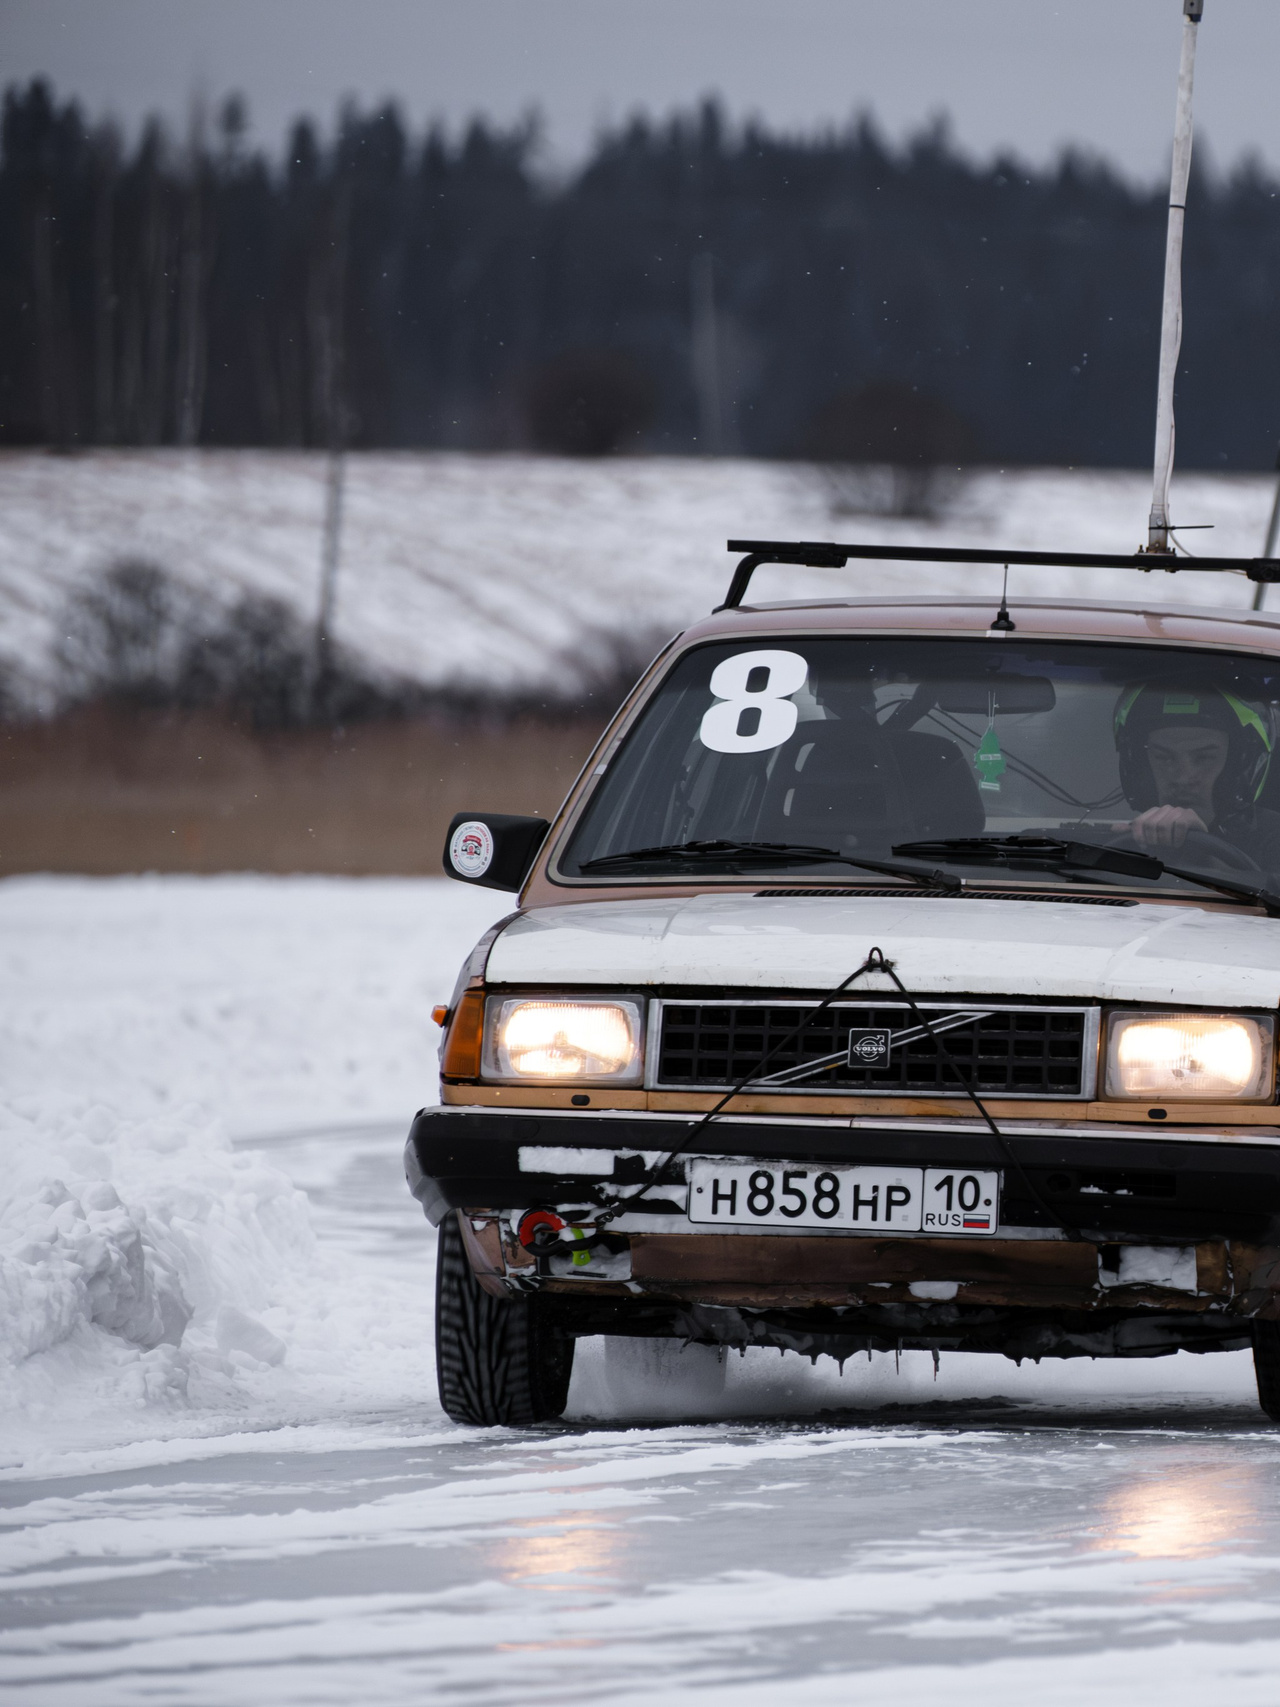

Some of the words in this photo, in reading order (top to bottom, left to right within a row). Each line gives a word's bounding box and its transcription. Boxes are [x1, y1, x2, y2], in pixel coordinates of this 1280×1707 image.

[699, 649, 809, 754] 8
[855, 1045, 885, 1053] VOLVO
[933, 1174, 981, 1212] 10
[925, 1212, 962, 1228] RUS
